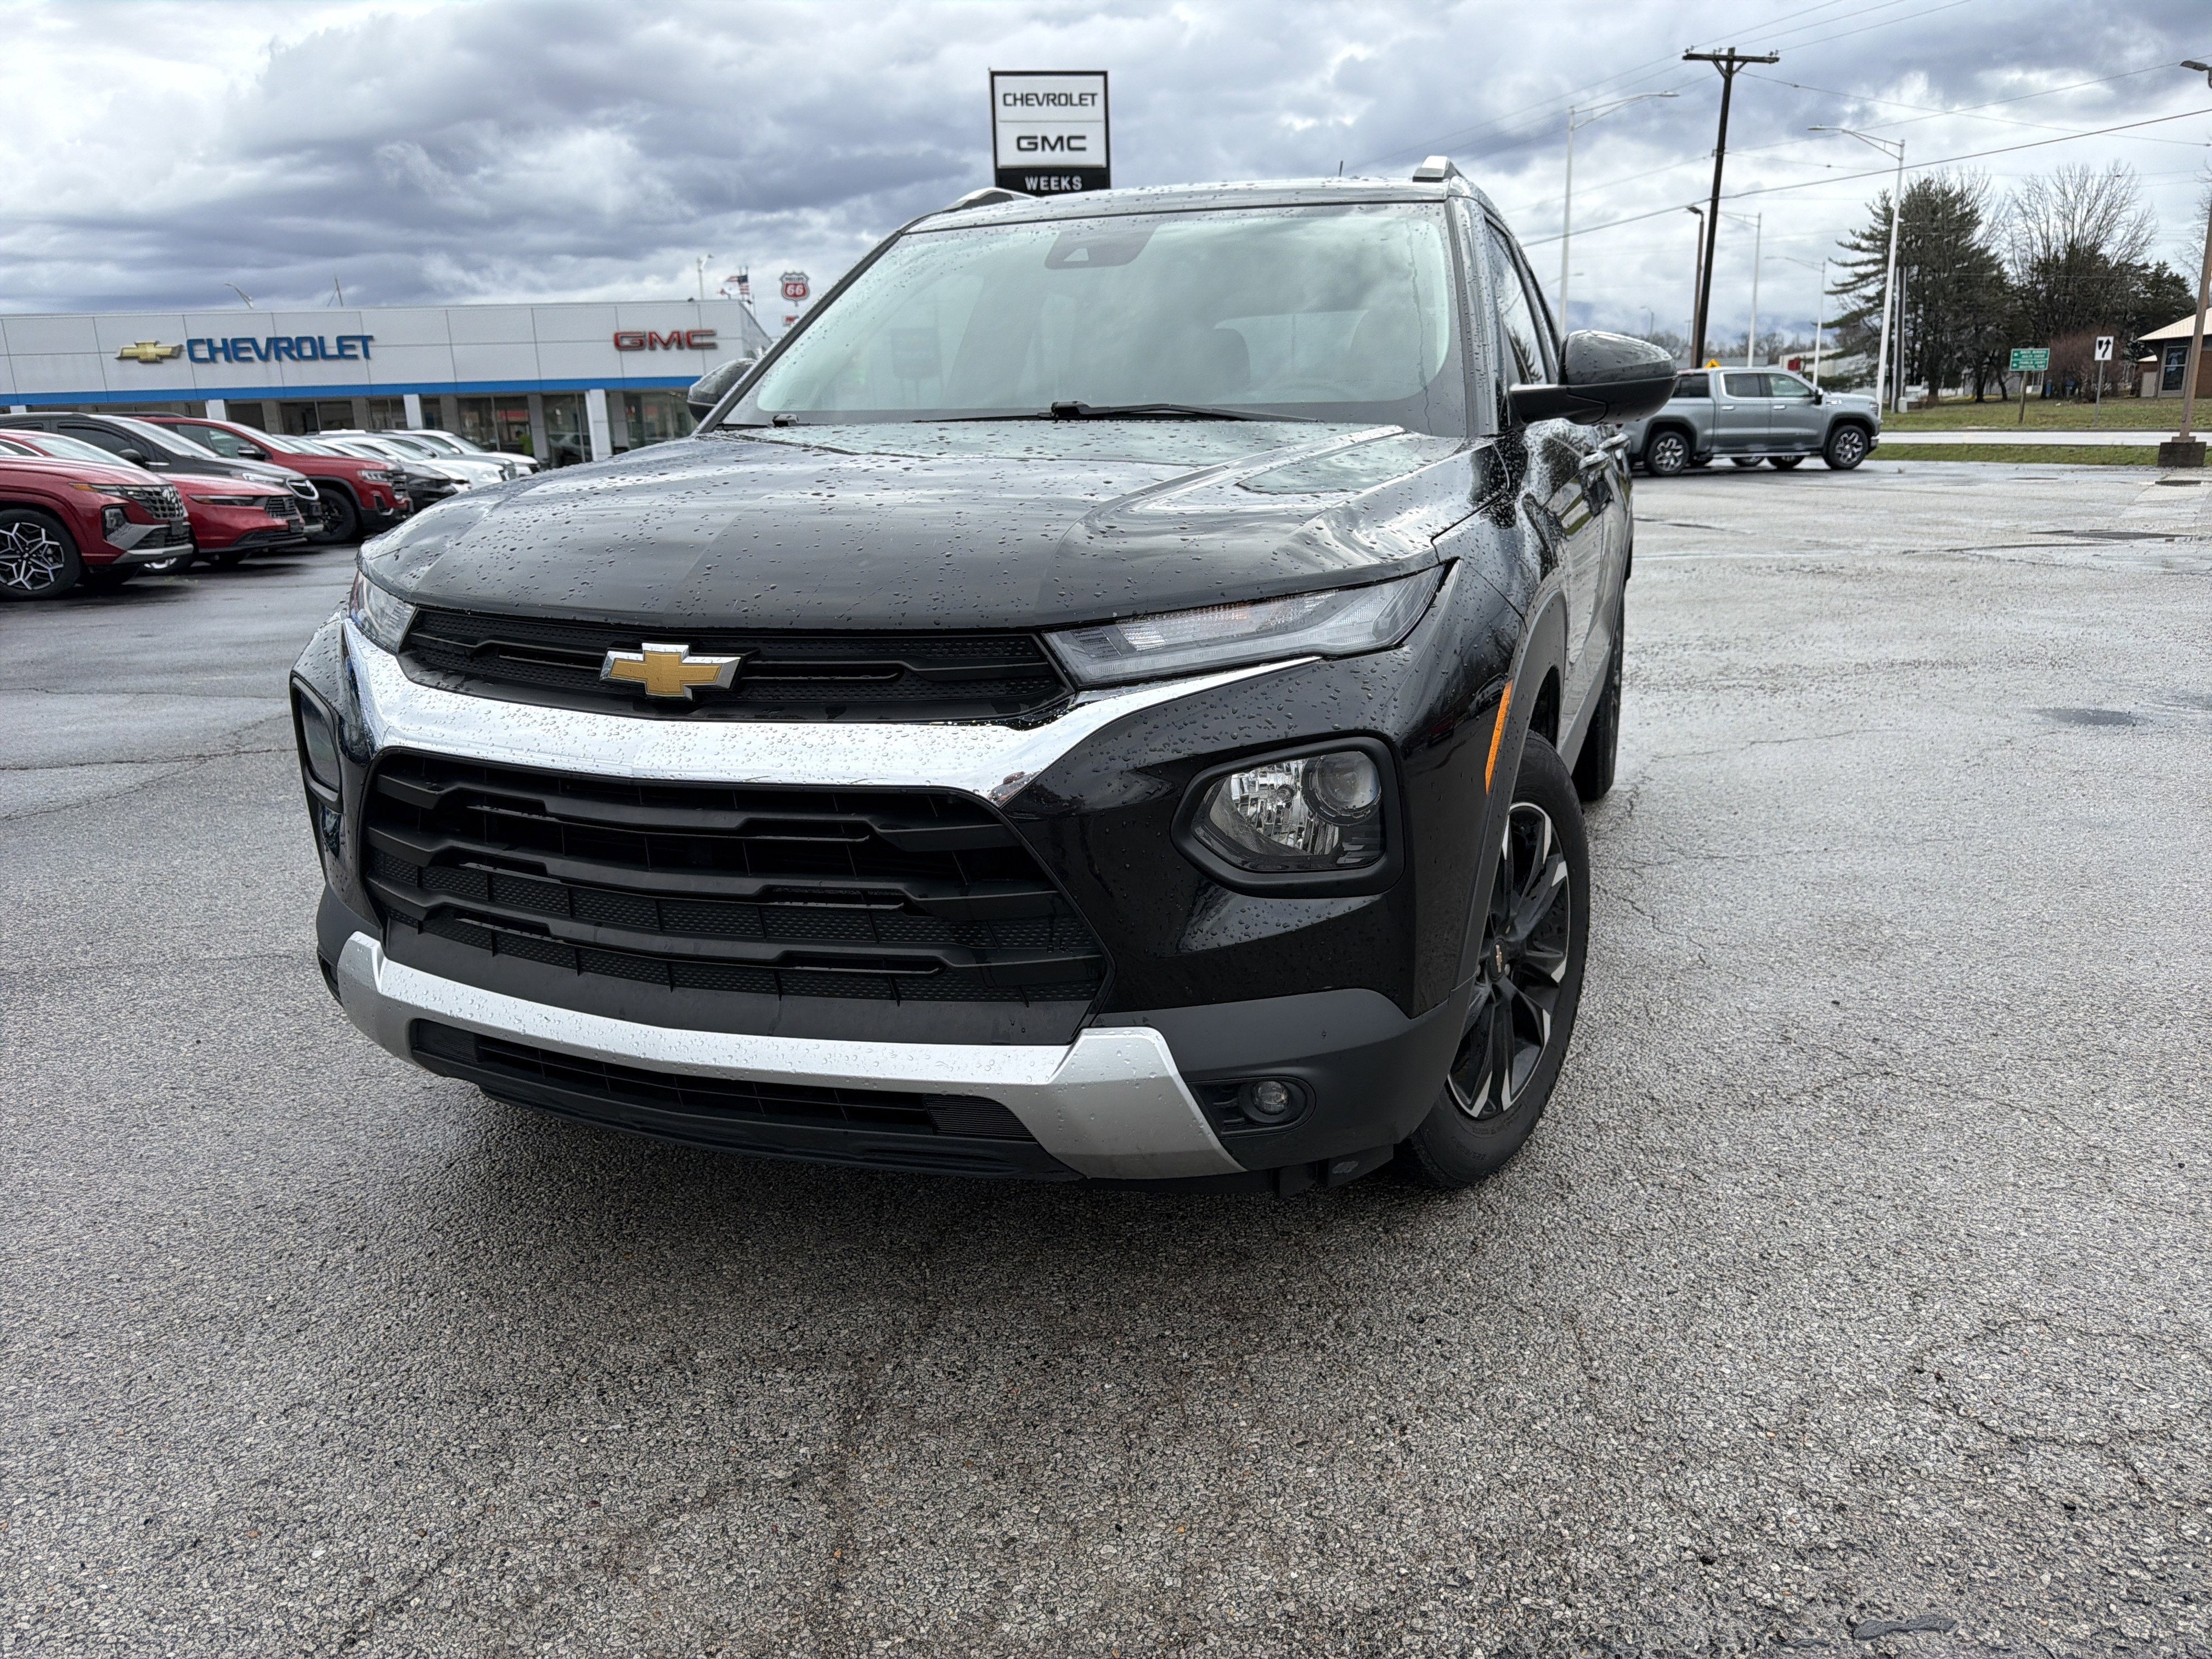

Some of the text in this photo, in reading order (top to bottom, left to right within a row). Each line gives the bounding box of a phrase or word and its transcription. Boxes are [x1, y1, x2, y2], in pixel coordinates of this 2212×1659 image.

[1003, 92, 1098, 106] CHEVROLET
[1017, 136, 1087, 152] GMC
[1024, 175, 1082, 191] WEEKS
[786, 284, 804, 296] 66
[614, 329, 718, 351] GMC
[186, 335, 374, 364] CHEVROLET
